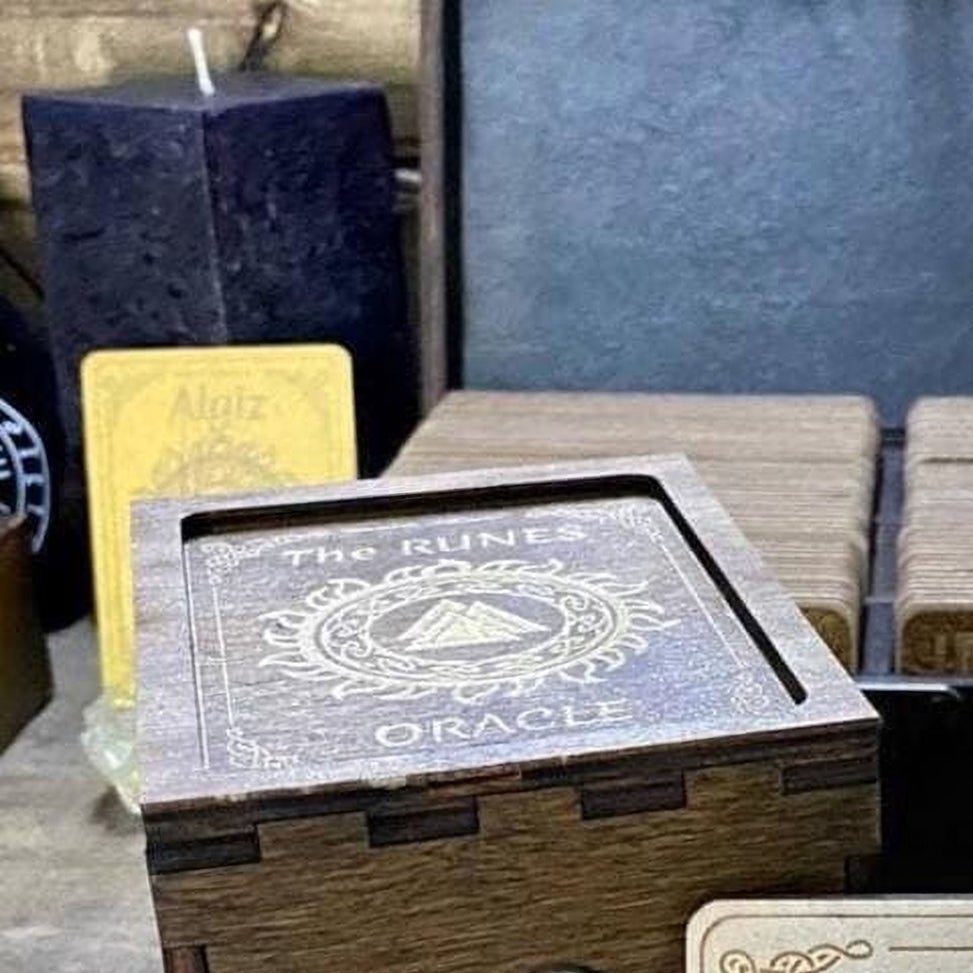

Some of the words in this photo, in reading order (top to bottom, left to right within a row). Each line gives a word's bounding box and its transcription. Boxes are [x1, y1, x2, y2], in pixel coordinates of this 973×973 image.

[283, 546, 377, 565] The
[401, 524, 586, 555] RUNES
[375, 699, 633, 747] ORACLE
